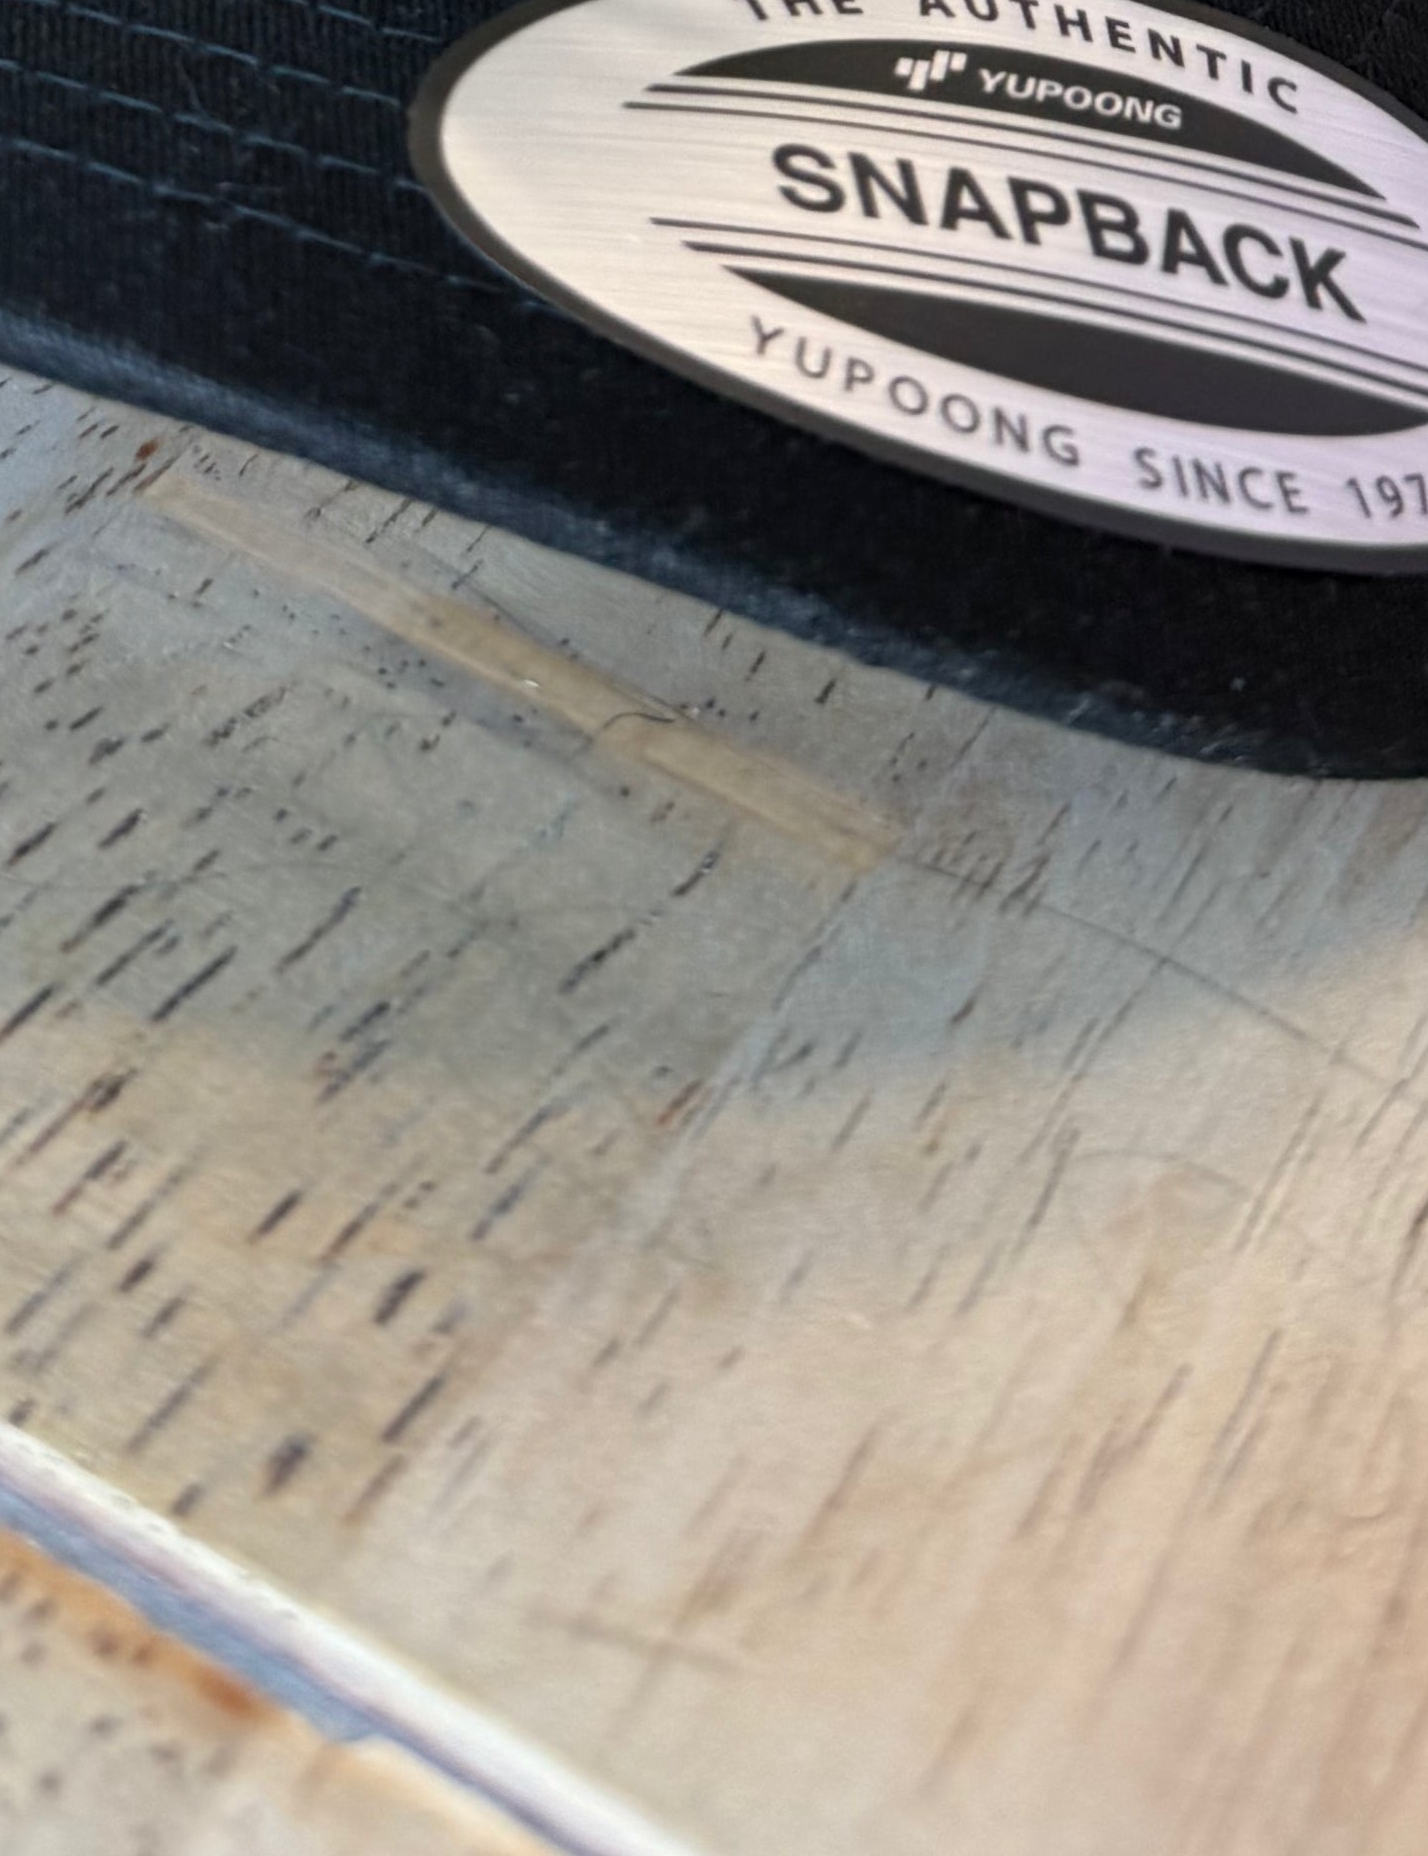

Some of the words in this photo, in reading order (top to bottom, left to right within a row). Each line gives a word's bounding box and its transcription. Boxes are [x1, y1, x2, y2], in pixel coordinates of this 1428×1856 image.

[978, 68, 1183, 130] YUPOONG
[772, 142, 1367, 323] SNAPBACK
[749, 314, 1081, 468] YUPOONG
[1132, 445, 1309, 514] SINCE
